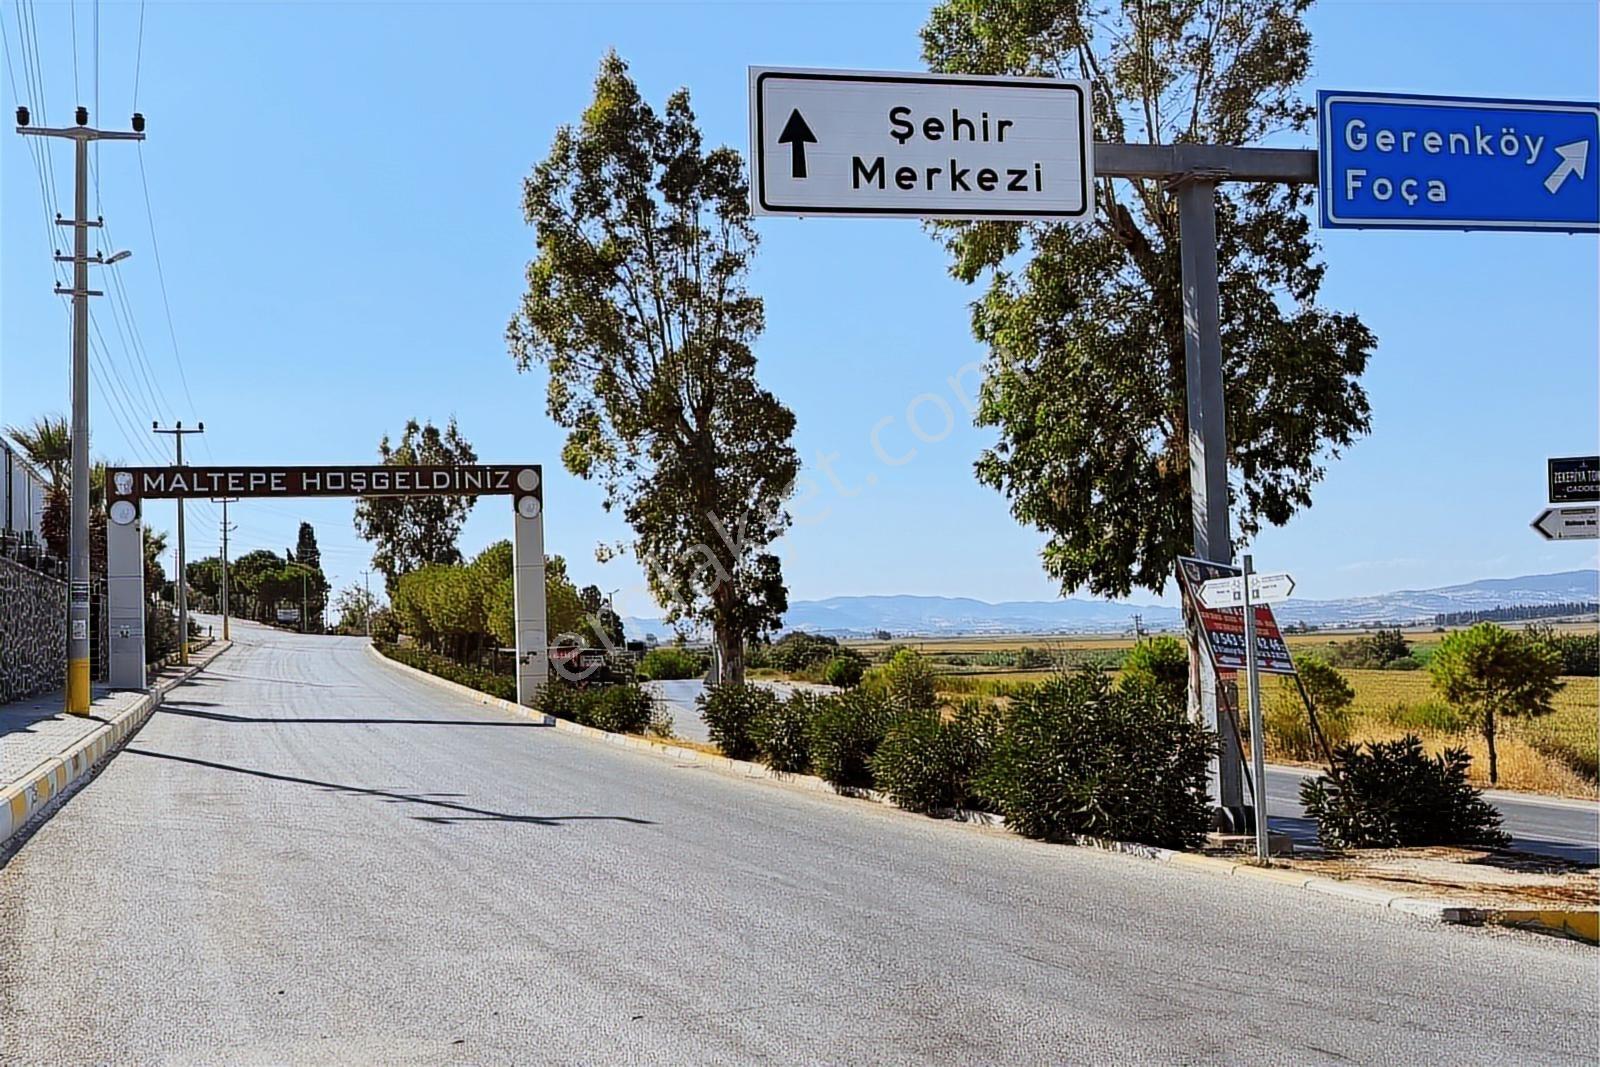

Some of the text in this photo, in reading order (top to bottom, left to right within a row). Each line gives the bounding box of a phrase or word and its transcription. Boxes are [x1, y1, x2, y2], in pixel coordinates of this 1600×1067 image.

[888, 105, 1014, 145] Şehir
[1344, 118, 1545, 165] Gerenköy
[851, 155, 1043, 193] Merkezi
[1345, 168, 1447, 206] Foça
[143, 466, 510, 493] MALTEPE HOŞGELDİNİZ
